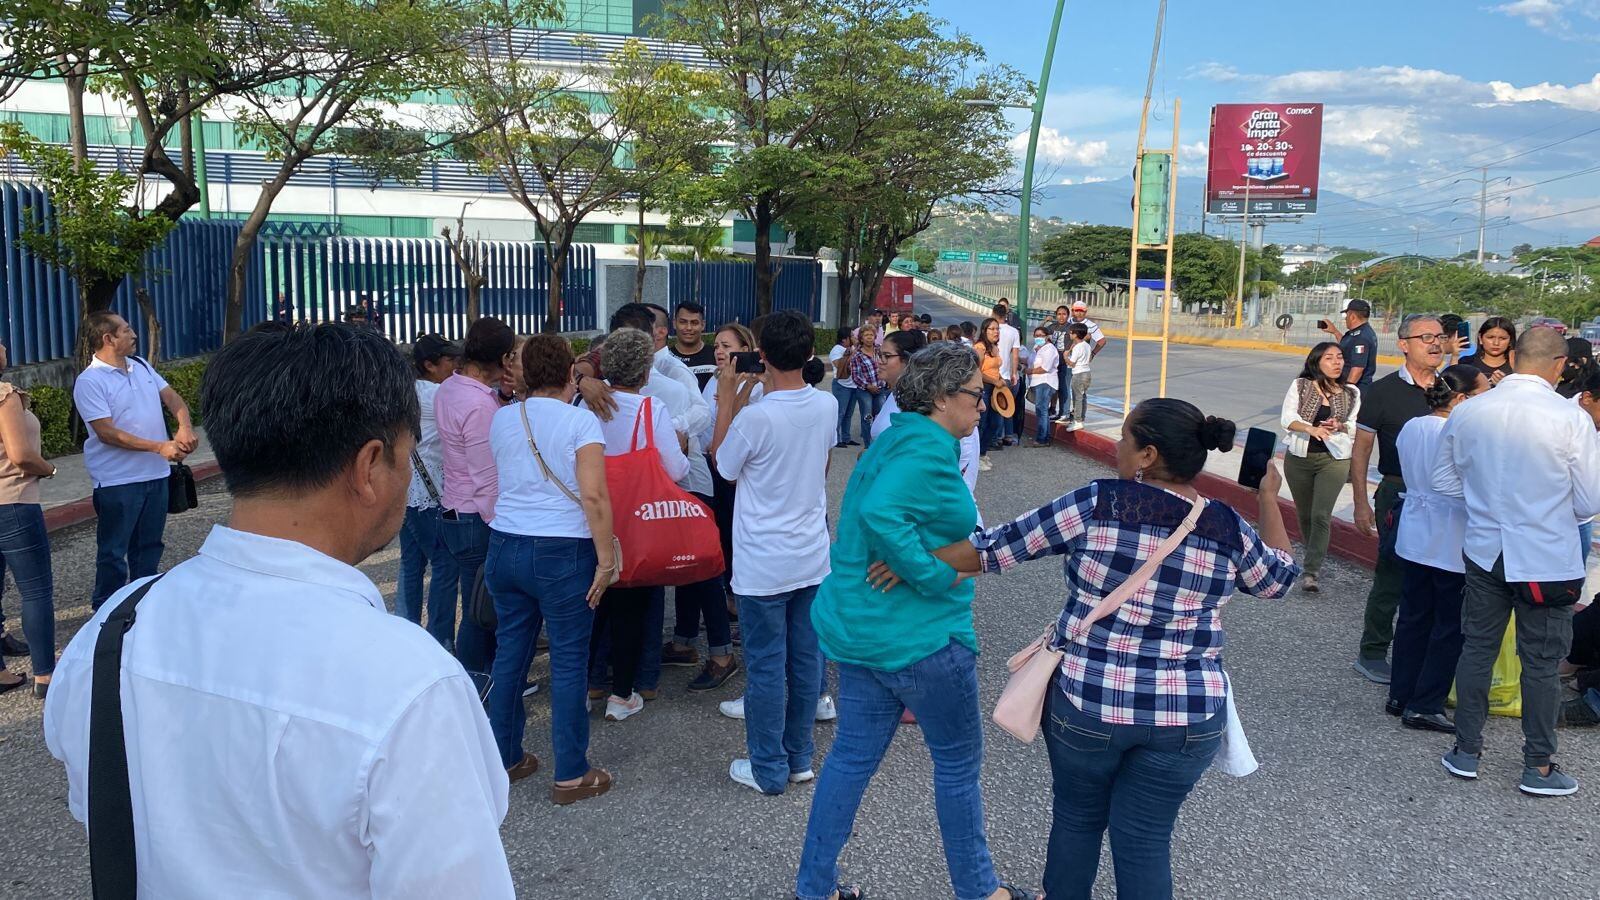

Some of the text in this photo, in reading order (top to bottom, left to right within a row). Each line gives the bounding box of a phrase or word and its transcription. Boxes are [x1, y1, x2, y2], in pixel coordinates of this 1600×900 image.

[1252, 110, 1278, 120] Gran
[1286, 106, 1315, 115] Comex
[1248, 119, 1281, 129] Venta
[1247, 128, 1280, 139] Imper
